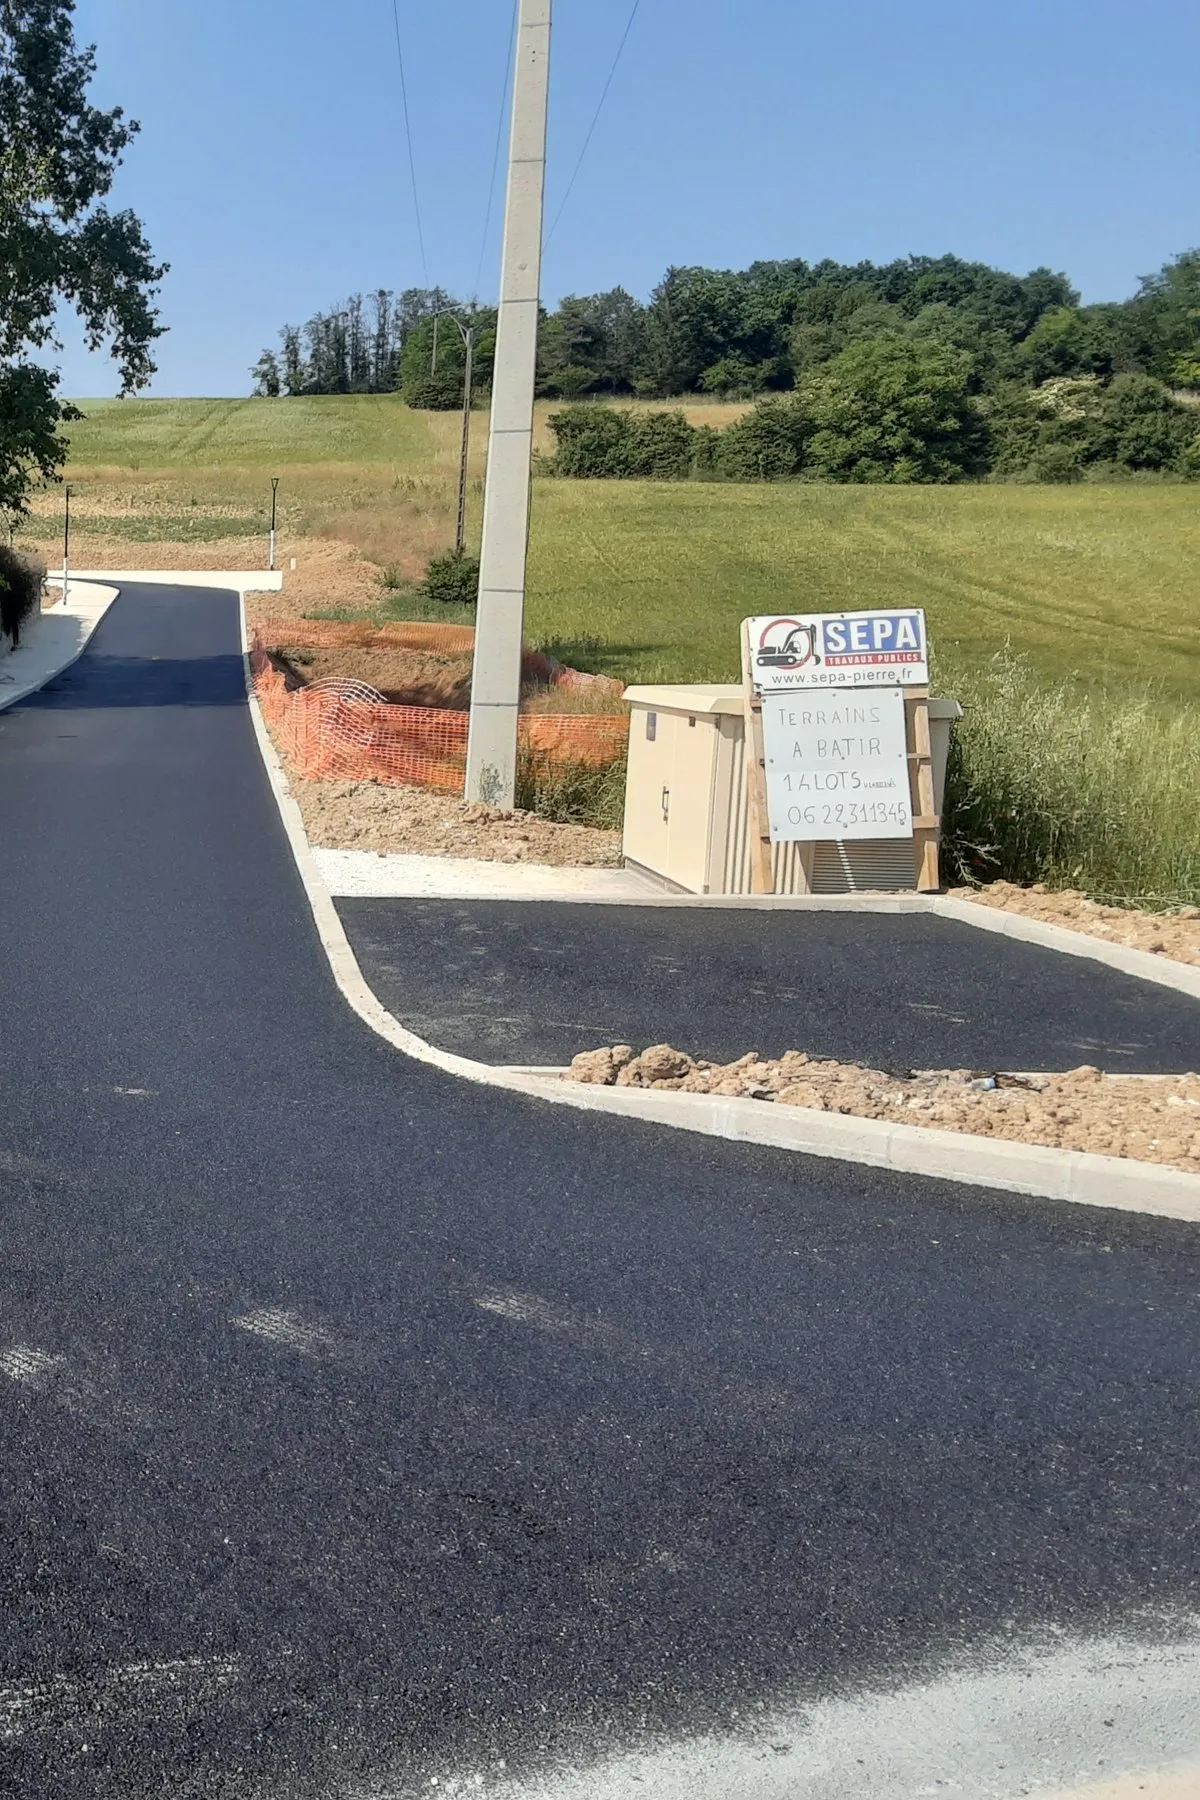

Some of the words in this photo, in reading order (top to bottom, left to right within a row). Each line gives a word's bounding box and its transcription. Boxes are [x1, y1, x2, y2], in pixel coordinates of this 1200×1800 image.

[826, 618, 918, 652] SEPA
[829, 654, 873, 665] TRAVAUX
[878, 653, 919, 663] PUBLICS
[772, 668, 913, 685] www.sepa-pierre.fr
[779, 707, 881, 726] TERRAINS
[792, 741, 803, 758] A
[817, 737, 881, 758] BATIR
